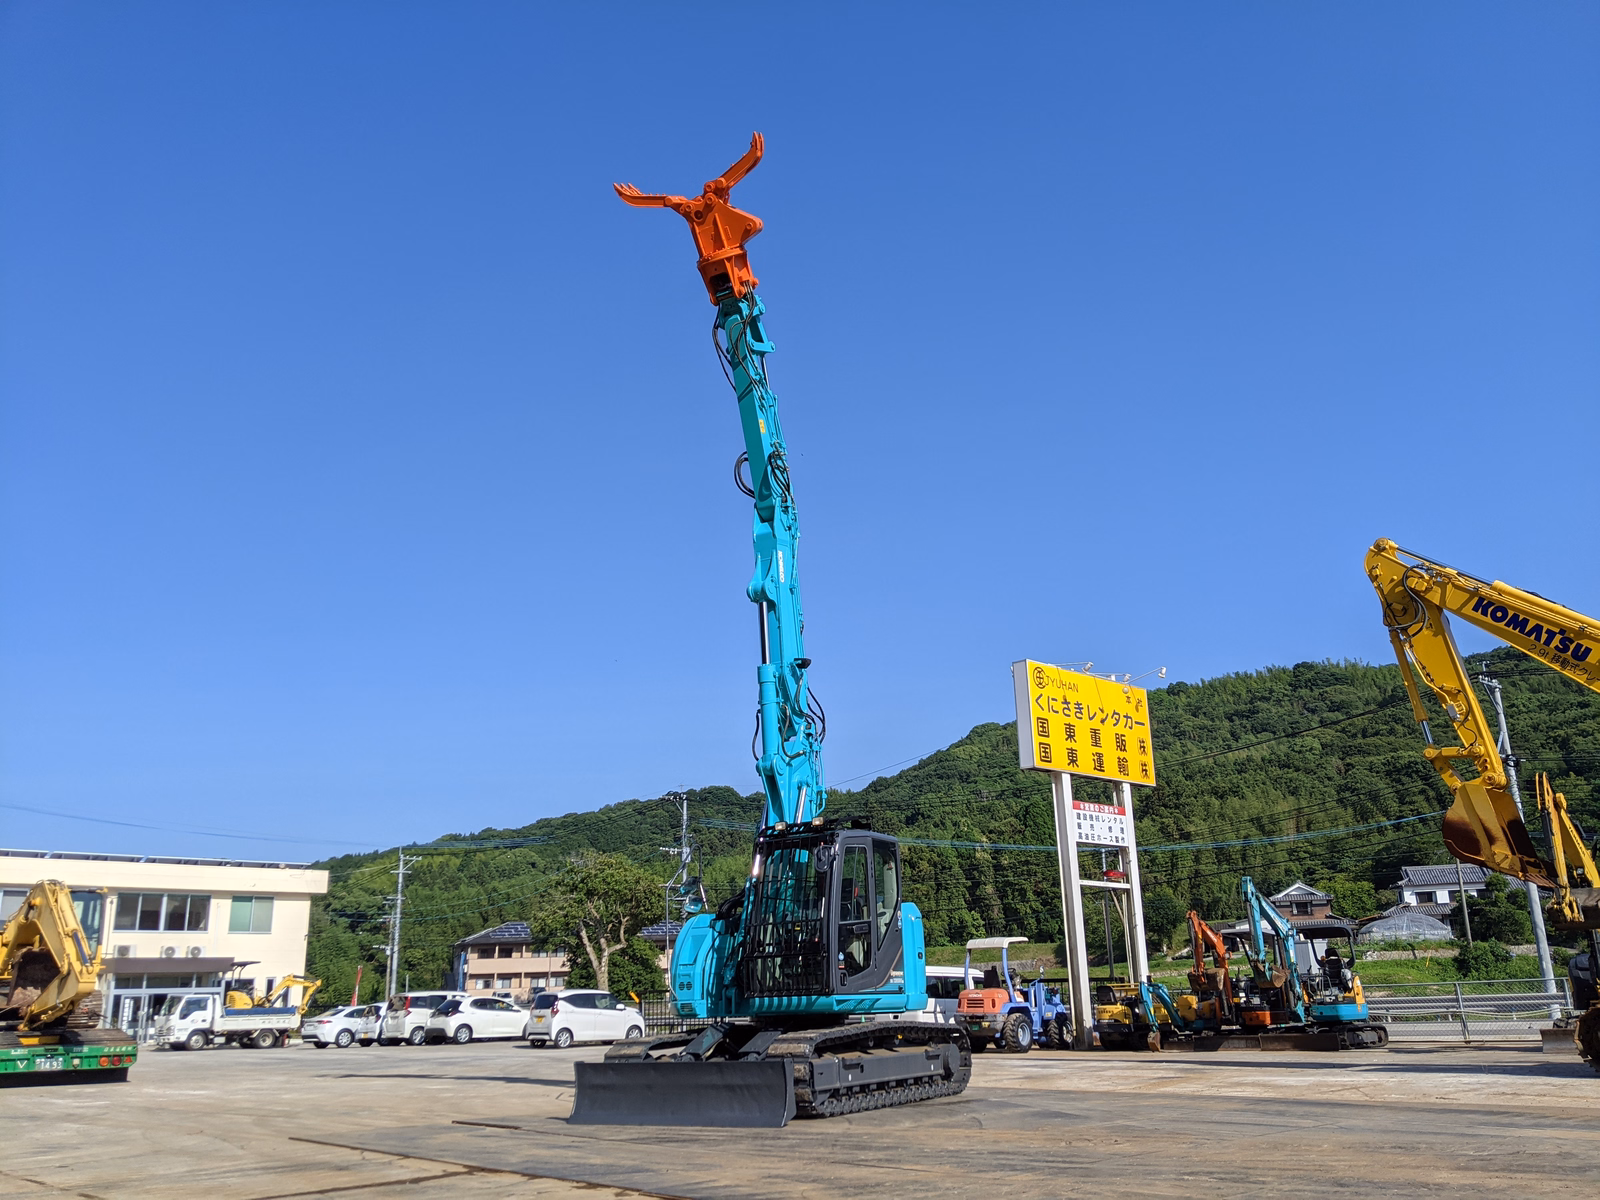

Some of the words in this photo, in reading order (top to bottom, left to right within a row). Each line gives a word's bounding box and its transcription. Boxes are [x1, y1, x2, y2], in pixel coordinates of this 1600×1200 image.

[1472, 596, 1592, 662] KOMATSU
[1045, 675, 1079, 693] JYUHAN
[1035, 693, 1146, 730] くにさきレンタカー
